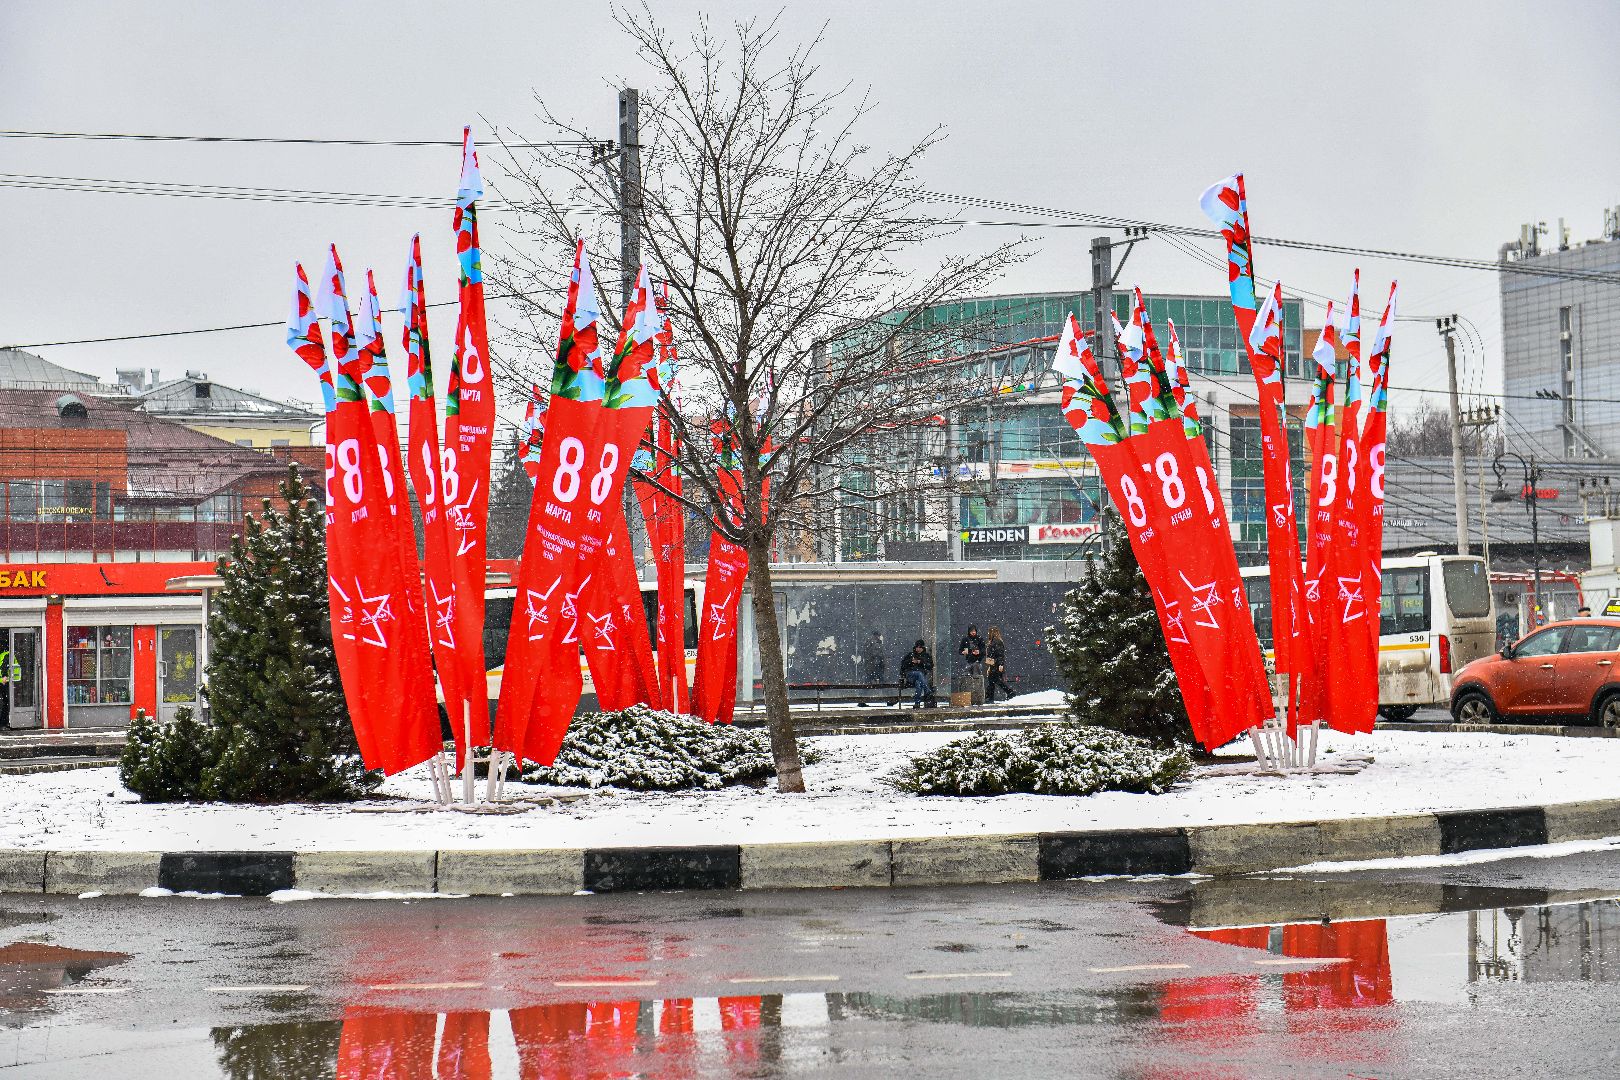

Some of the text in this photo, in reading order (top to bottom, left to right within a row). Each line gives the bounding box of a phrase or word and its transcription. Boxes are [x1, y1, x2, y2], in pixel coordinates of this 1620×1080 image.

[337, 438, 364, 504] 8
[553, 437, 585, 503] 8
[590, 442, 619, 506] 8
[1155, 451, 1186, 509] 8
[545, 501, 572, 524] МАРТА
[1120, 473, 1147, 528] 8
[970, 528, 1025, 543] ZENDEN
[0, 570, 47, 588] БАК
